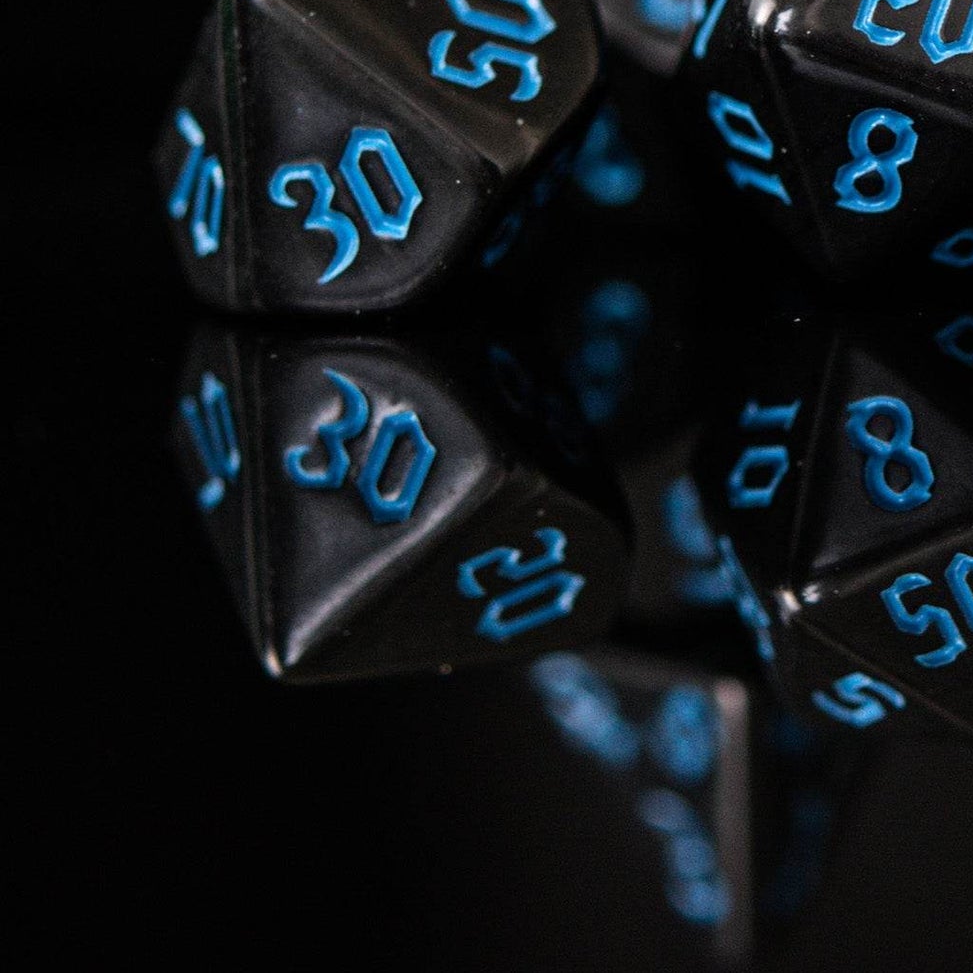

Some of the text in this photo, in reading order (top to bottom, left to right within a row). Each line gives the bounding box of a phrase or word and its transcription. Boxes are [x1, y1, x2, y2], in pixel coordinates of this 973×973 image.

[266, 126, 424, 287] 30
[705, 89, 793, 208] 10
[832, 107, 921, 215] 8
